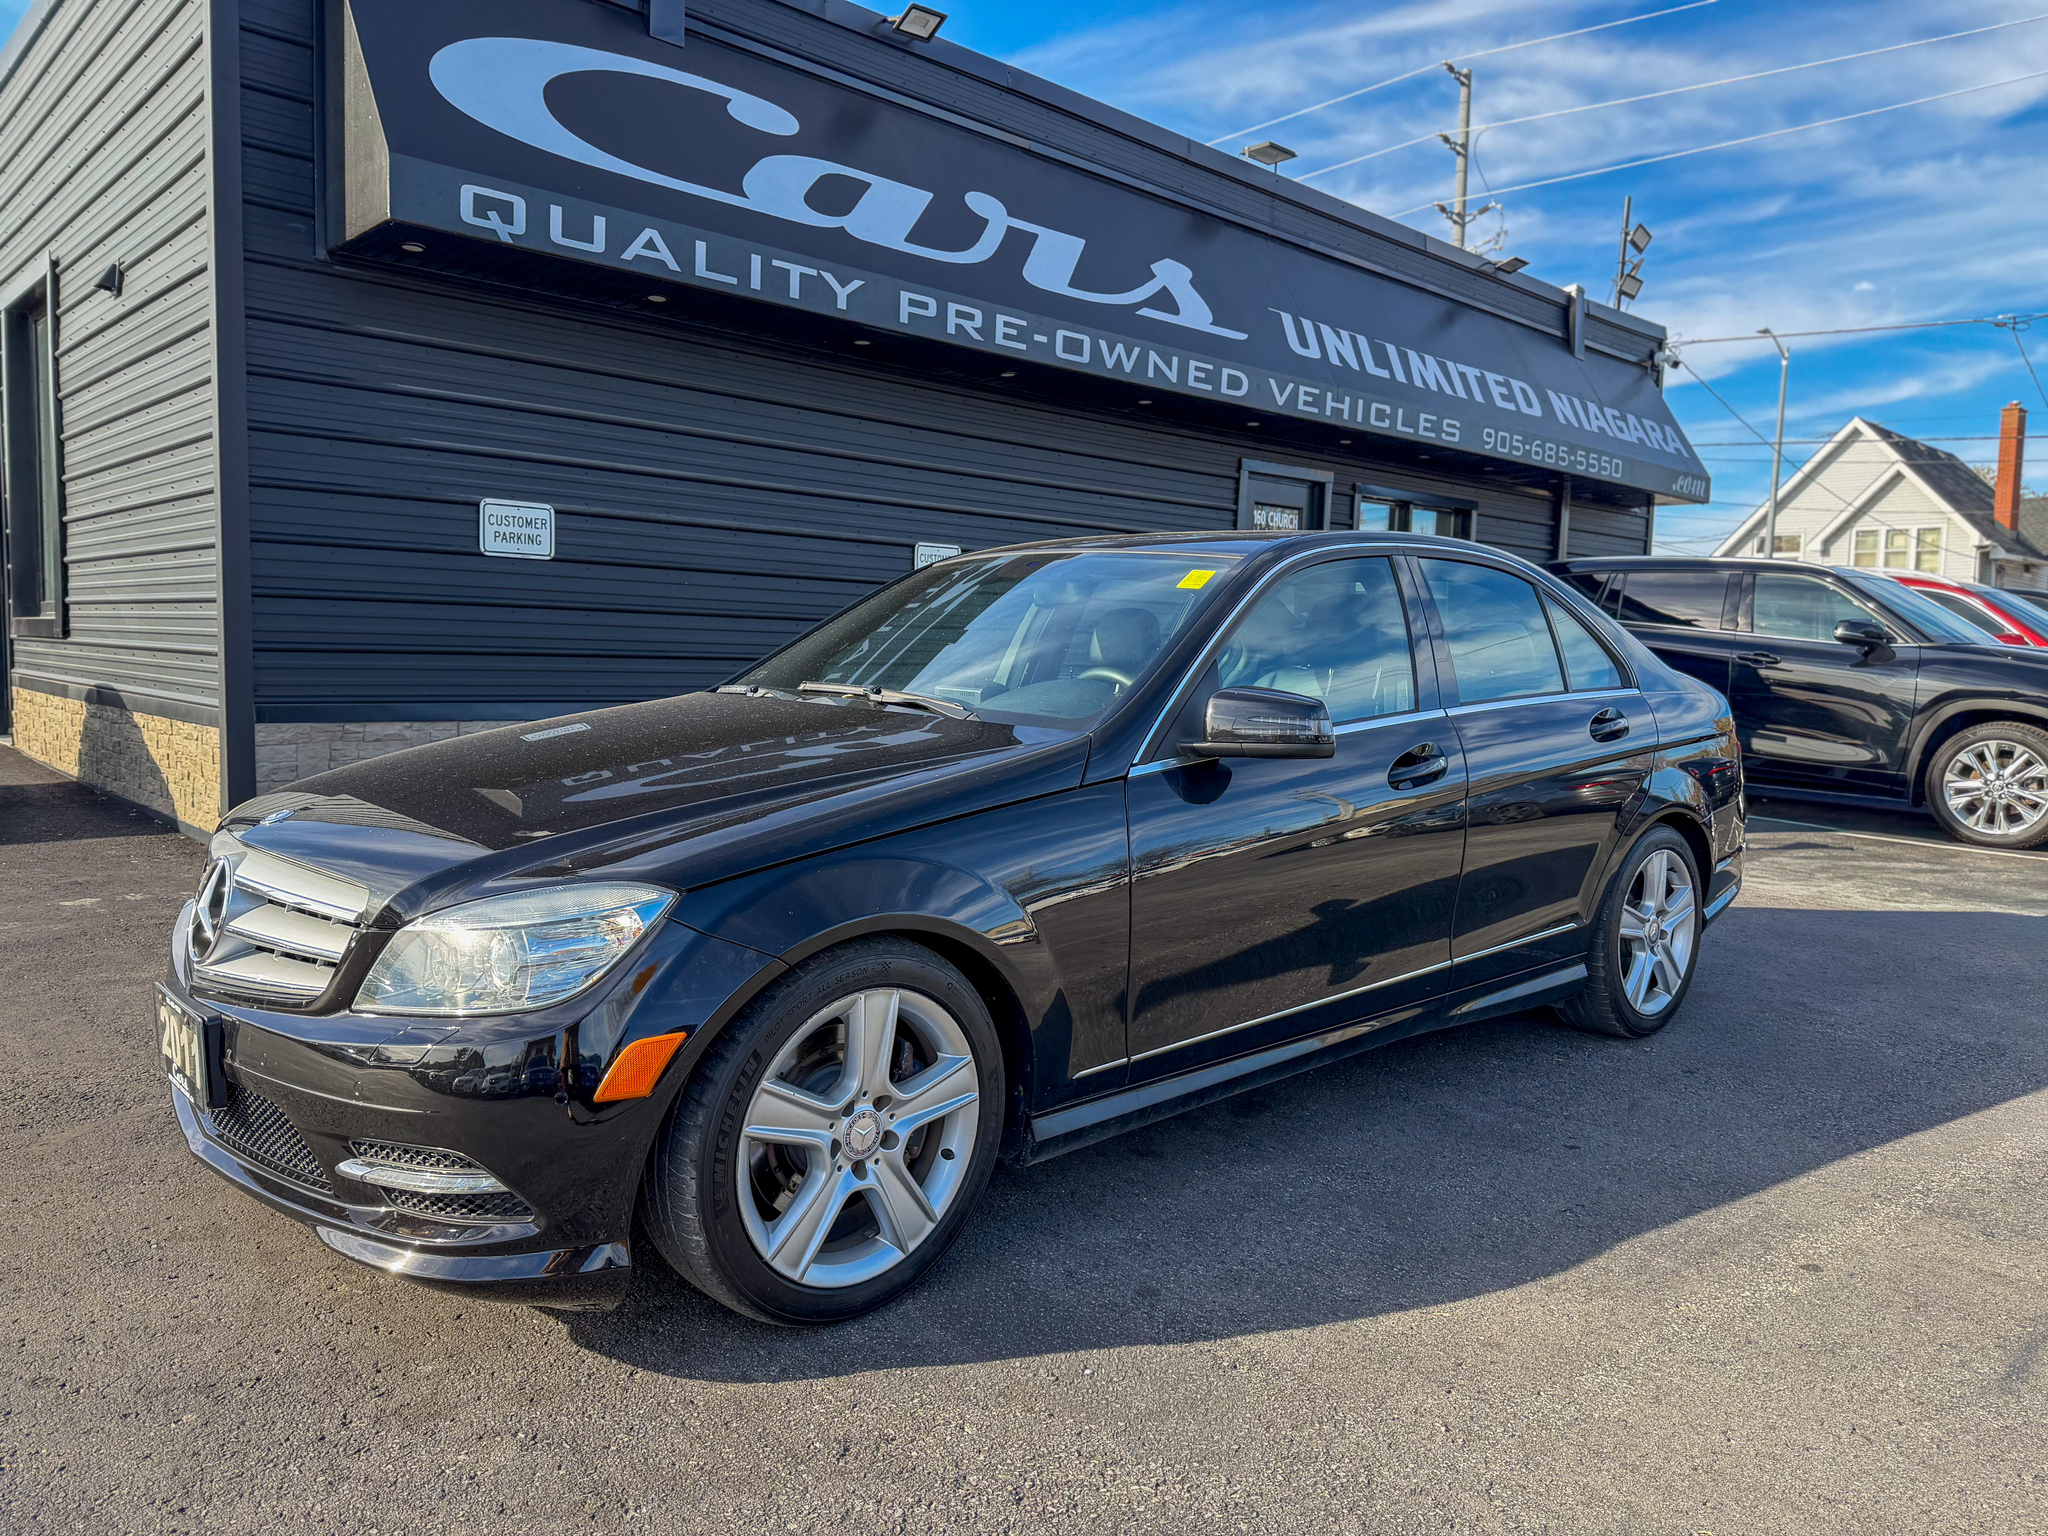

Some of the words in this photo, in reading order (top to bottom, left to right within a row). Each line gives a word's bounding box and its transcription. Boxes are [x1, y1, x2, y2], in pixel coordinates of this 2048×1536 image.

[429, 37, 1248, 341] Cars
[1268, 307, 1543, 418] UNLIMITED
[1546, 389, 1690, 458] NIAGARA
[459, 184, 866, 311] QUALITY
[899, 290, 1249, 398] PRE-OWNED
[1268, 377, 1461, 443] VEHICLES
[1482, 427, 1623, 479] 905-685-5550
[487, 513, 548, 531] CUSTOMER
[1253, 509, 1266, 526] 160
[1268, 511, 1299, 530] CHURCH
[1672, 475, 1706, 498] .com
[493, 530, 542, 546] PARKING
[763, 1017, 786, 1044] PILOT
[786, 993, 813, 1019] SPORT
[815, 981, 832, 996] ALL
[834, 966, 870, 985] SEASON
[160, 1005, 202, 1090] 2011
[713, 1056, 760, 1184] MICHELIN
